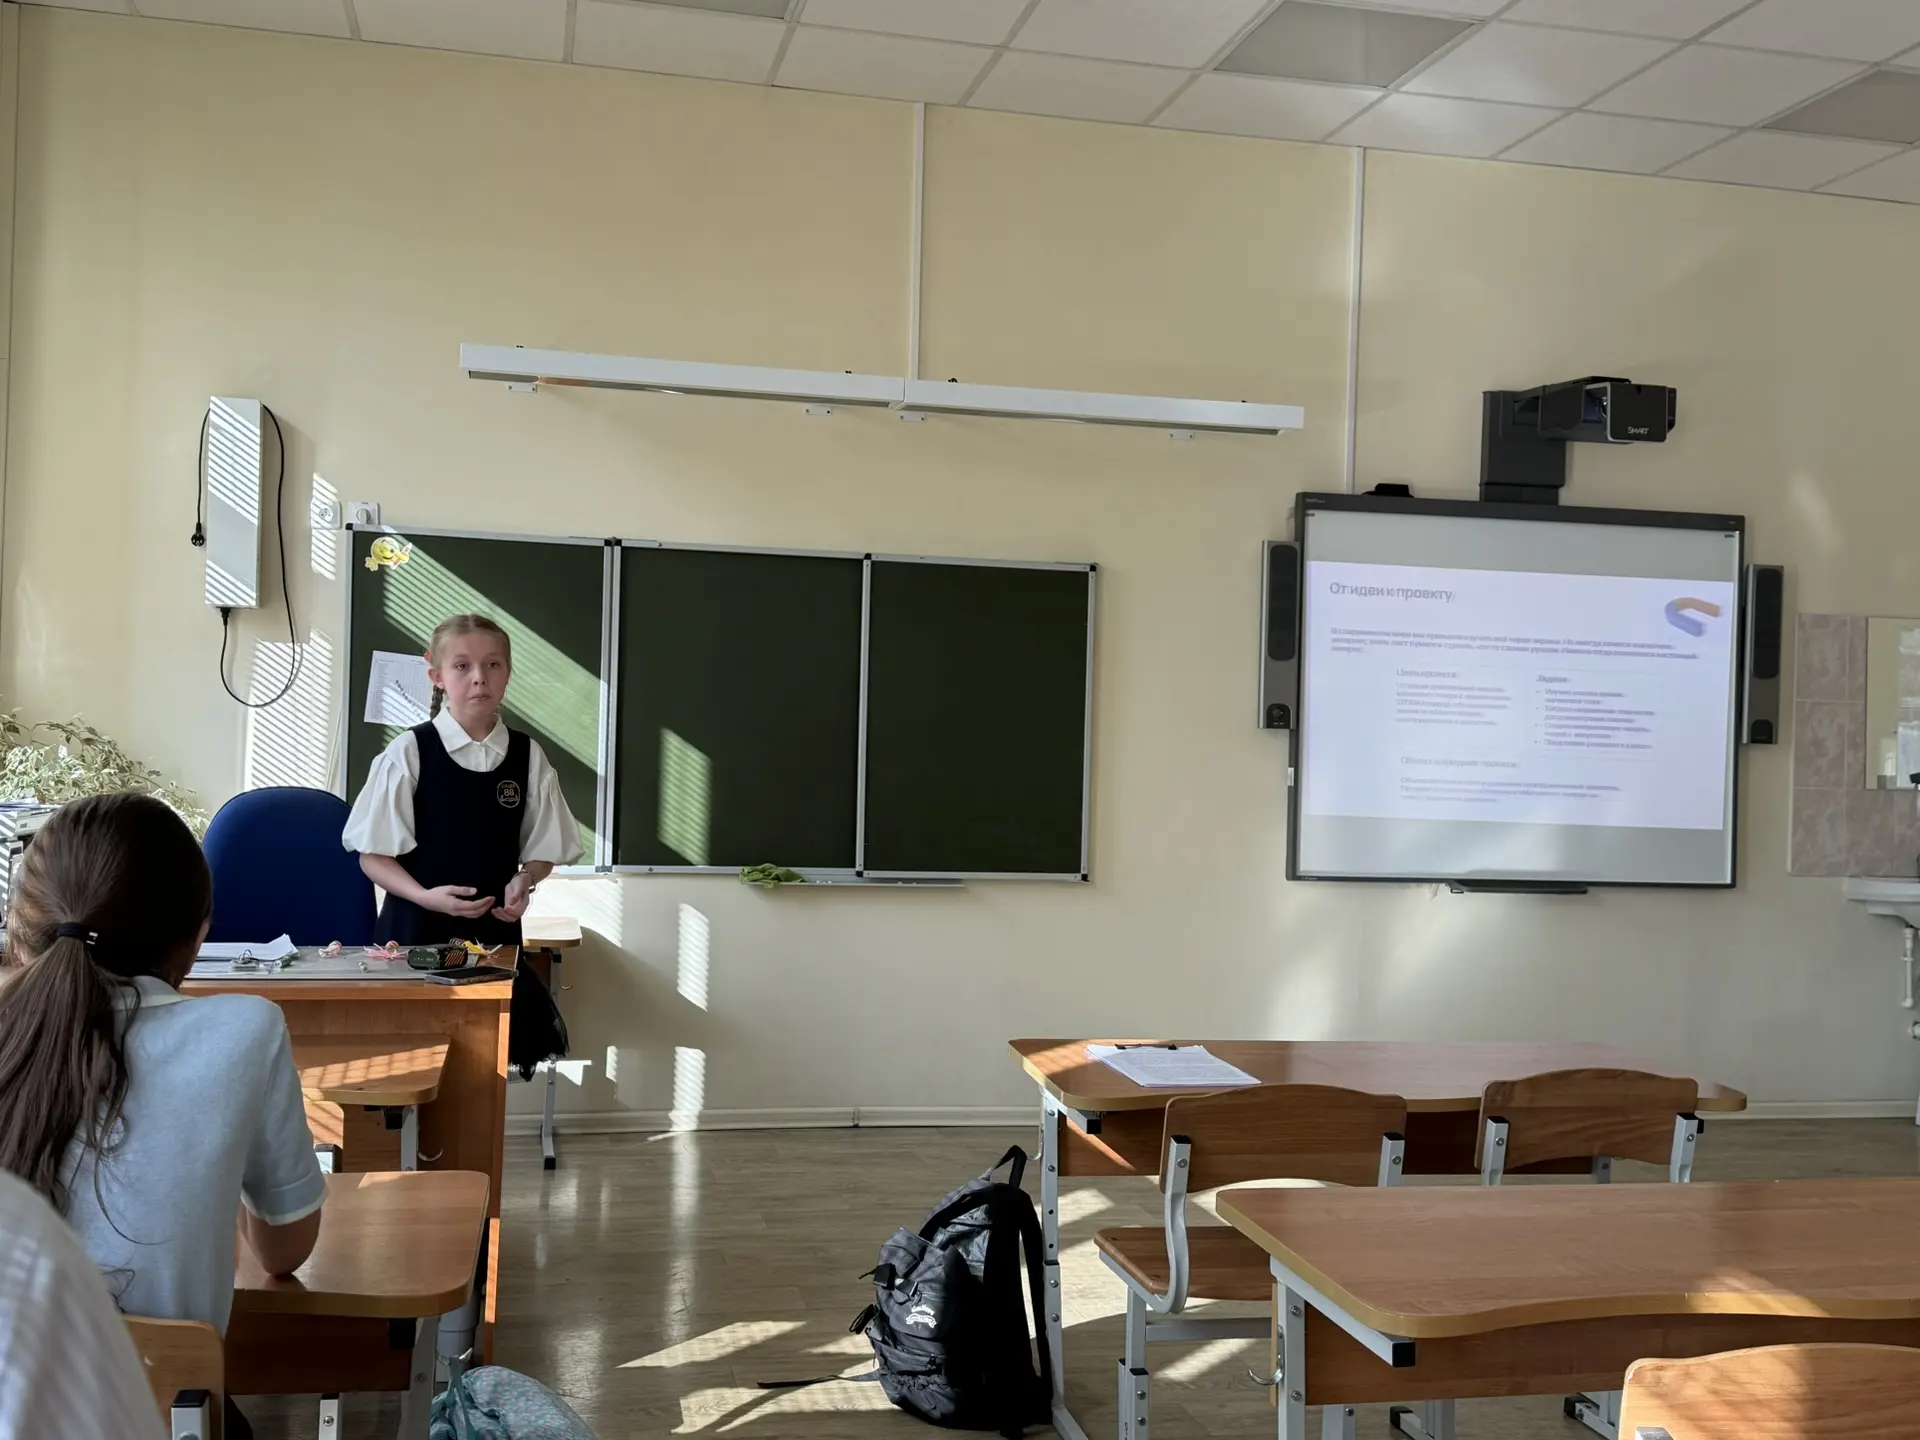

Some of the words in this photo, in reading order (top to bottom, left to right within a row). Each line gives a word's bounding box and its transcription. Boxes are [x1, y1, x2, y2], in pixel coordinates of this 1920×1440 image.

[1627, 426, 1650, 435] SMART
[1329, 582, 1348, 595] От
[1350, 584, 1385, 597] идеи
[1396, 587, 1454, 604] проекту
